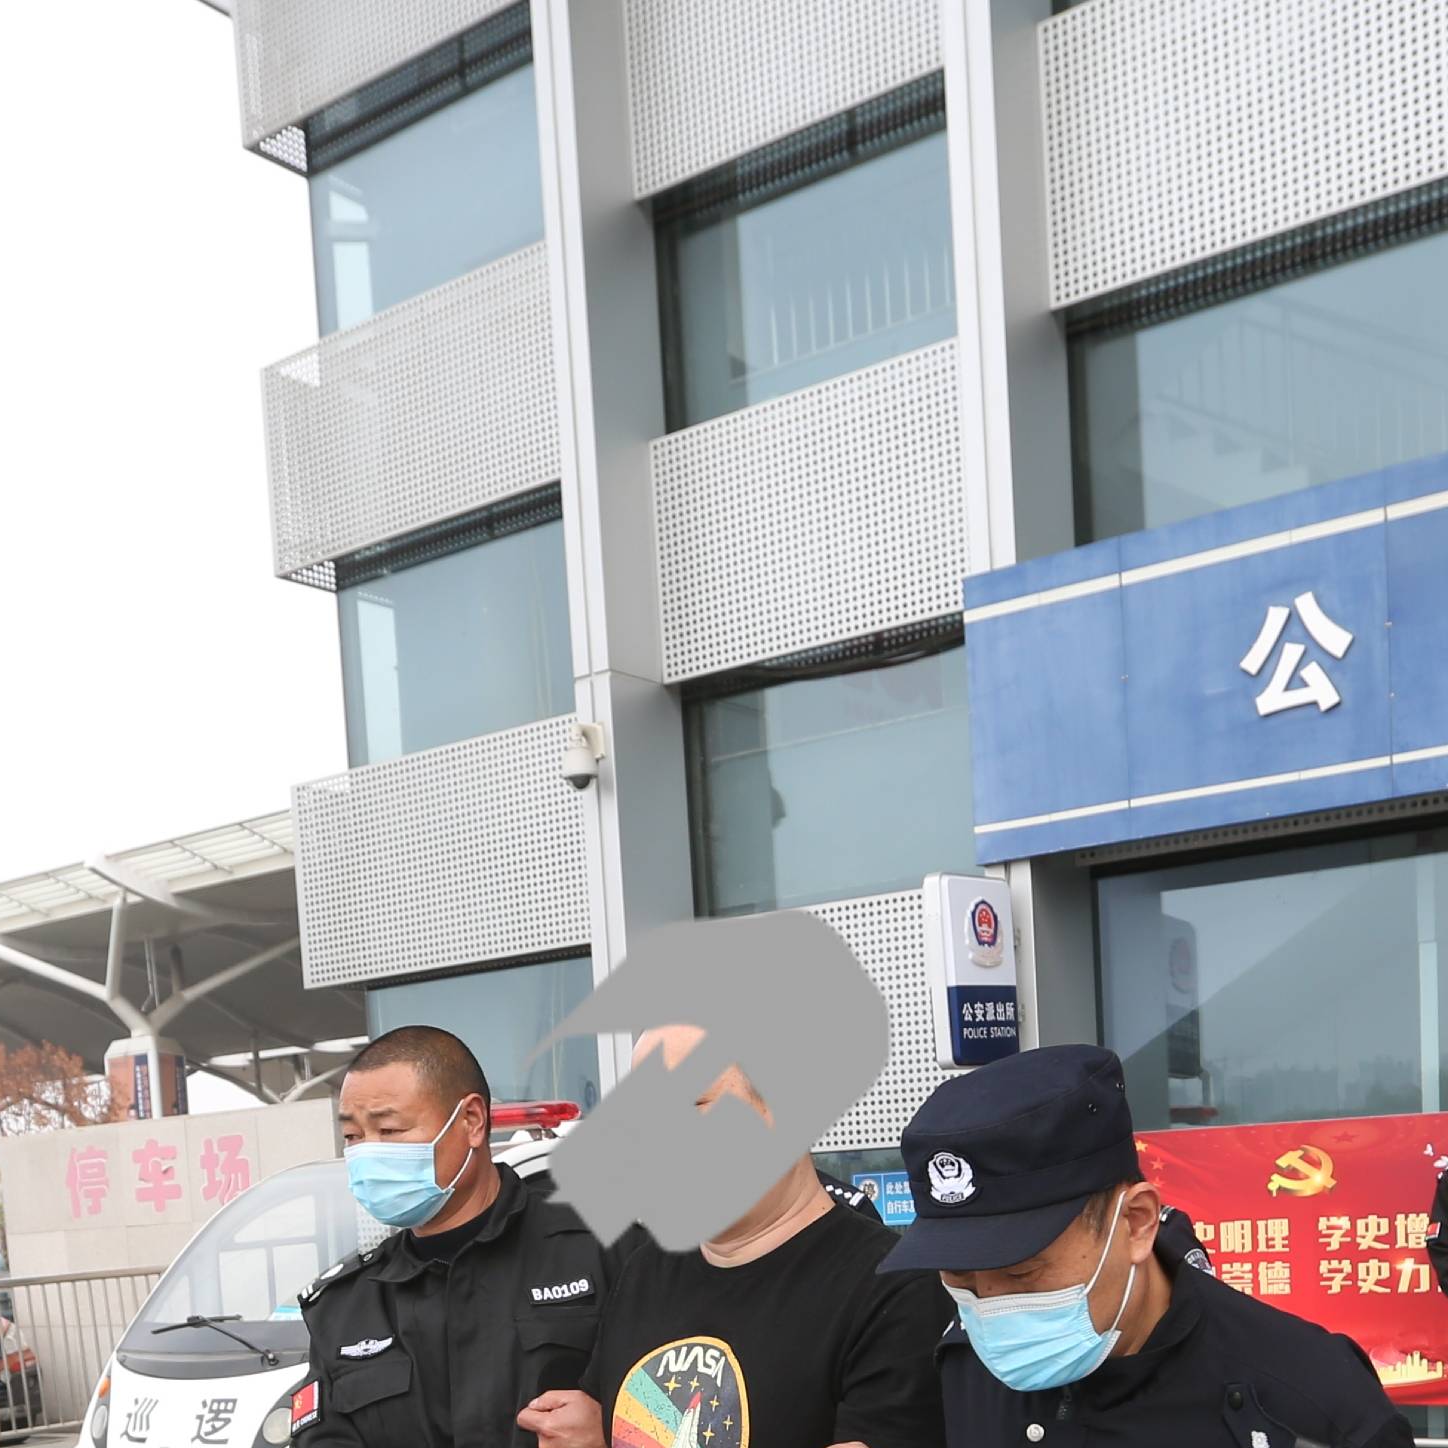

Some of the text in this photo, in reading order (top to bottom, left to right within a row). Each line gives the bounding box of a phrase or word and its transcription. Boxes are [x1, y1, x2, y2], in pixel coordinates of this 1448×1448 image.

[962, 1001, 1015, 1022] 公安派出所
[963, 1026, 1017, 1039] POLICE STATION
[65, 1135, 251, 1220] 停车场
[1318, 1213, 1430, 1252] 学史增
[531, 1278, 589, 1301] BA0109
[1211, 1257, 1442, 1296] 崇德 学史力
[655, 1345, 726, 1388] NASA
[120, 1397, 238, 1445] 巡逻
